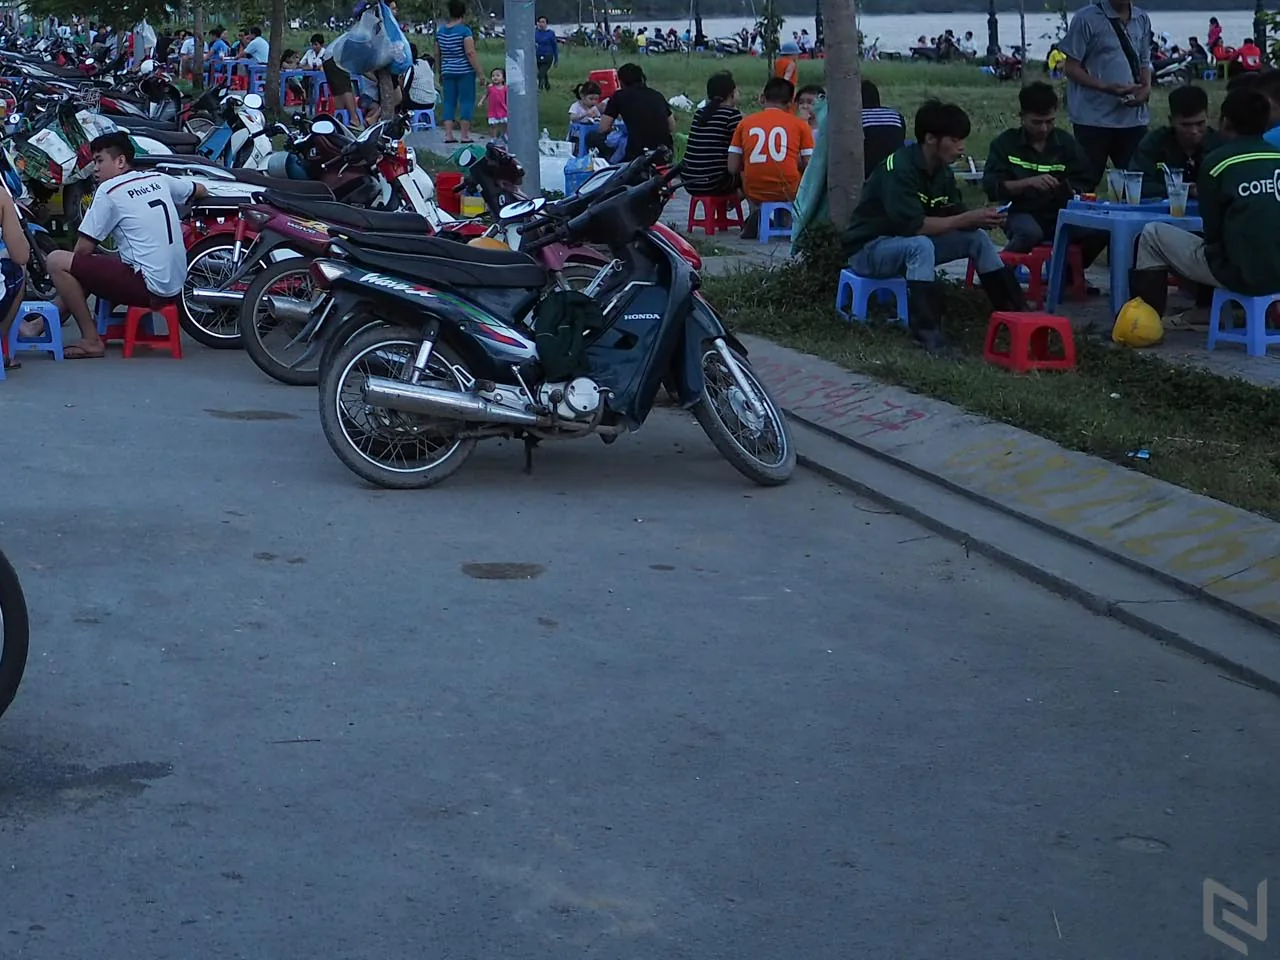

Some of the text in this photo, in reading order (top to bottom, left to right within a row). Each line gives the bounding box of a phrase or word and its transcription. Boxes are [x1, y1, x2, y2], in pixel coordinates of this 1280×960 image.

[749, 126, 788, 164] 20
[1238, 179, 1277, 197] COTE
[147, 199, 173, 245] 7
